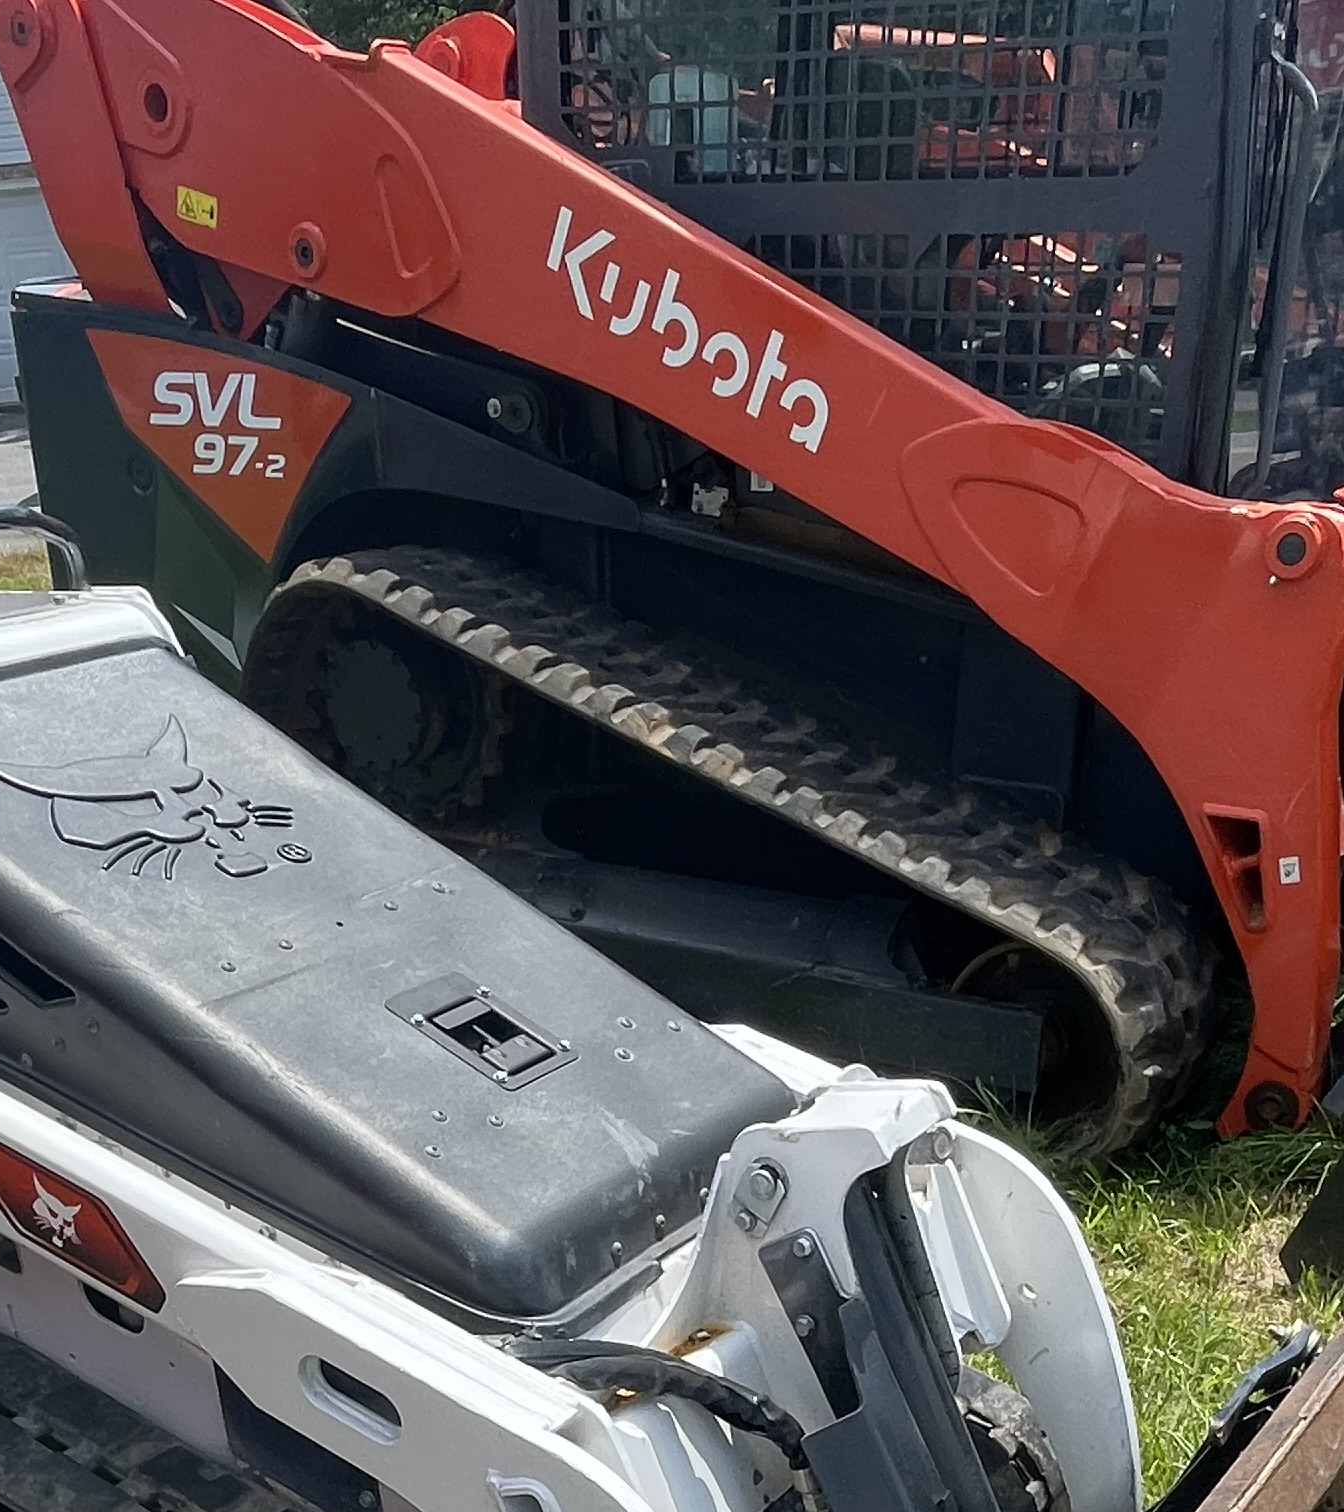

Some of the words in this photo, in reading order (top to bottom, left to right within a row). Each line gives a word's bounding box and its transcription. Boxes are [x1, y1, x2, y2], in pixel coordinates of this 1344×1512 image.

[546, 205, 830, 454] Kubota
[149, 371, 282, 430] SVL
[192, 432, 287, 479] 97-2
